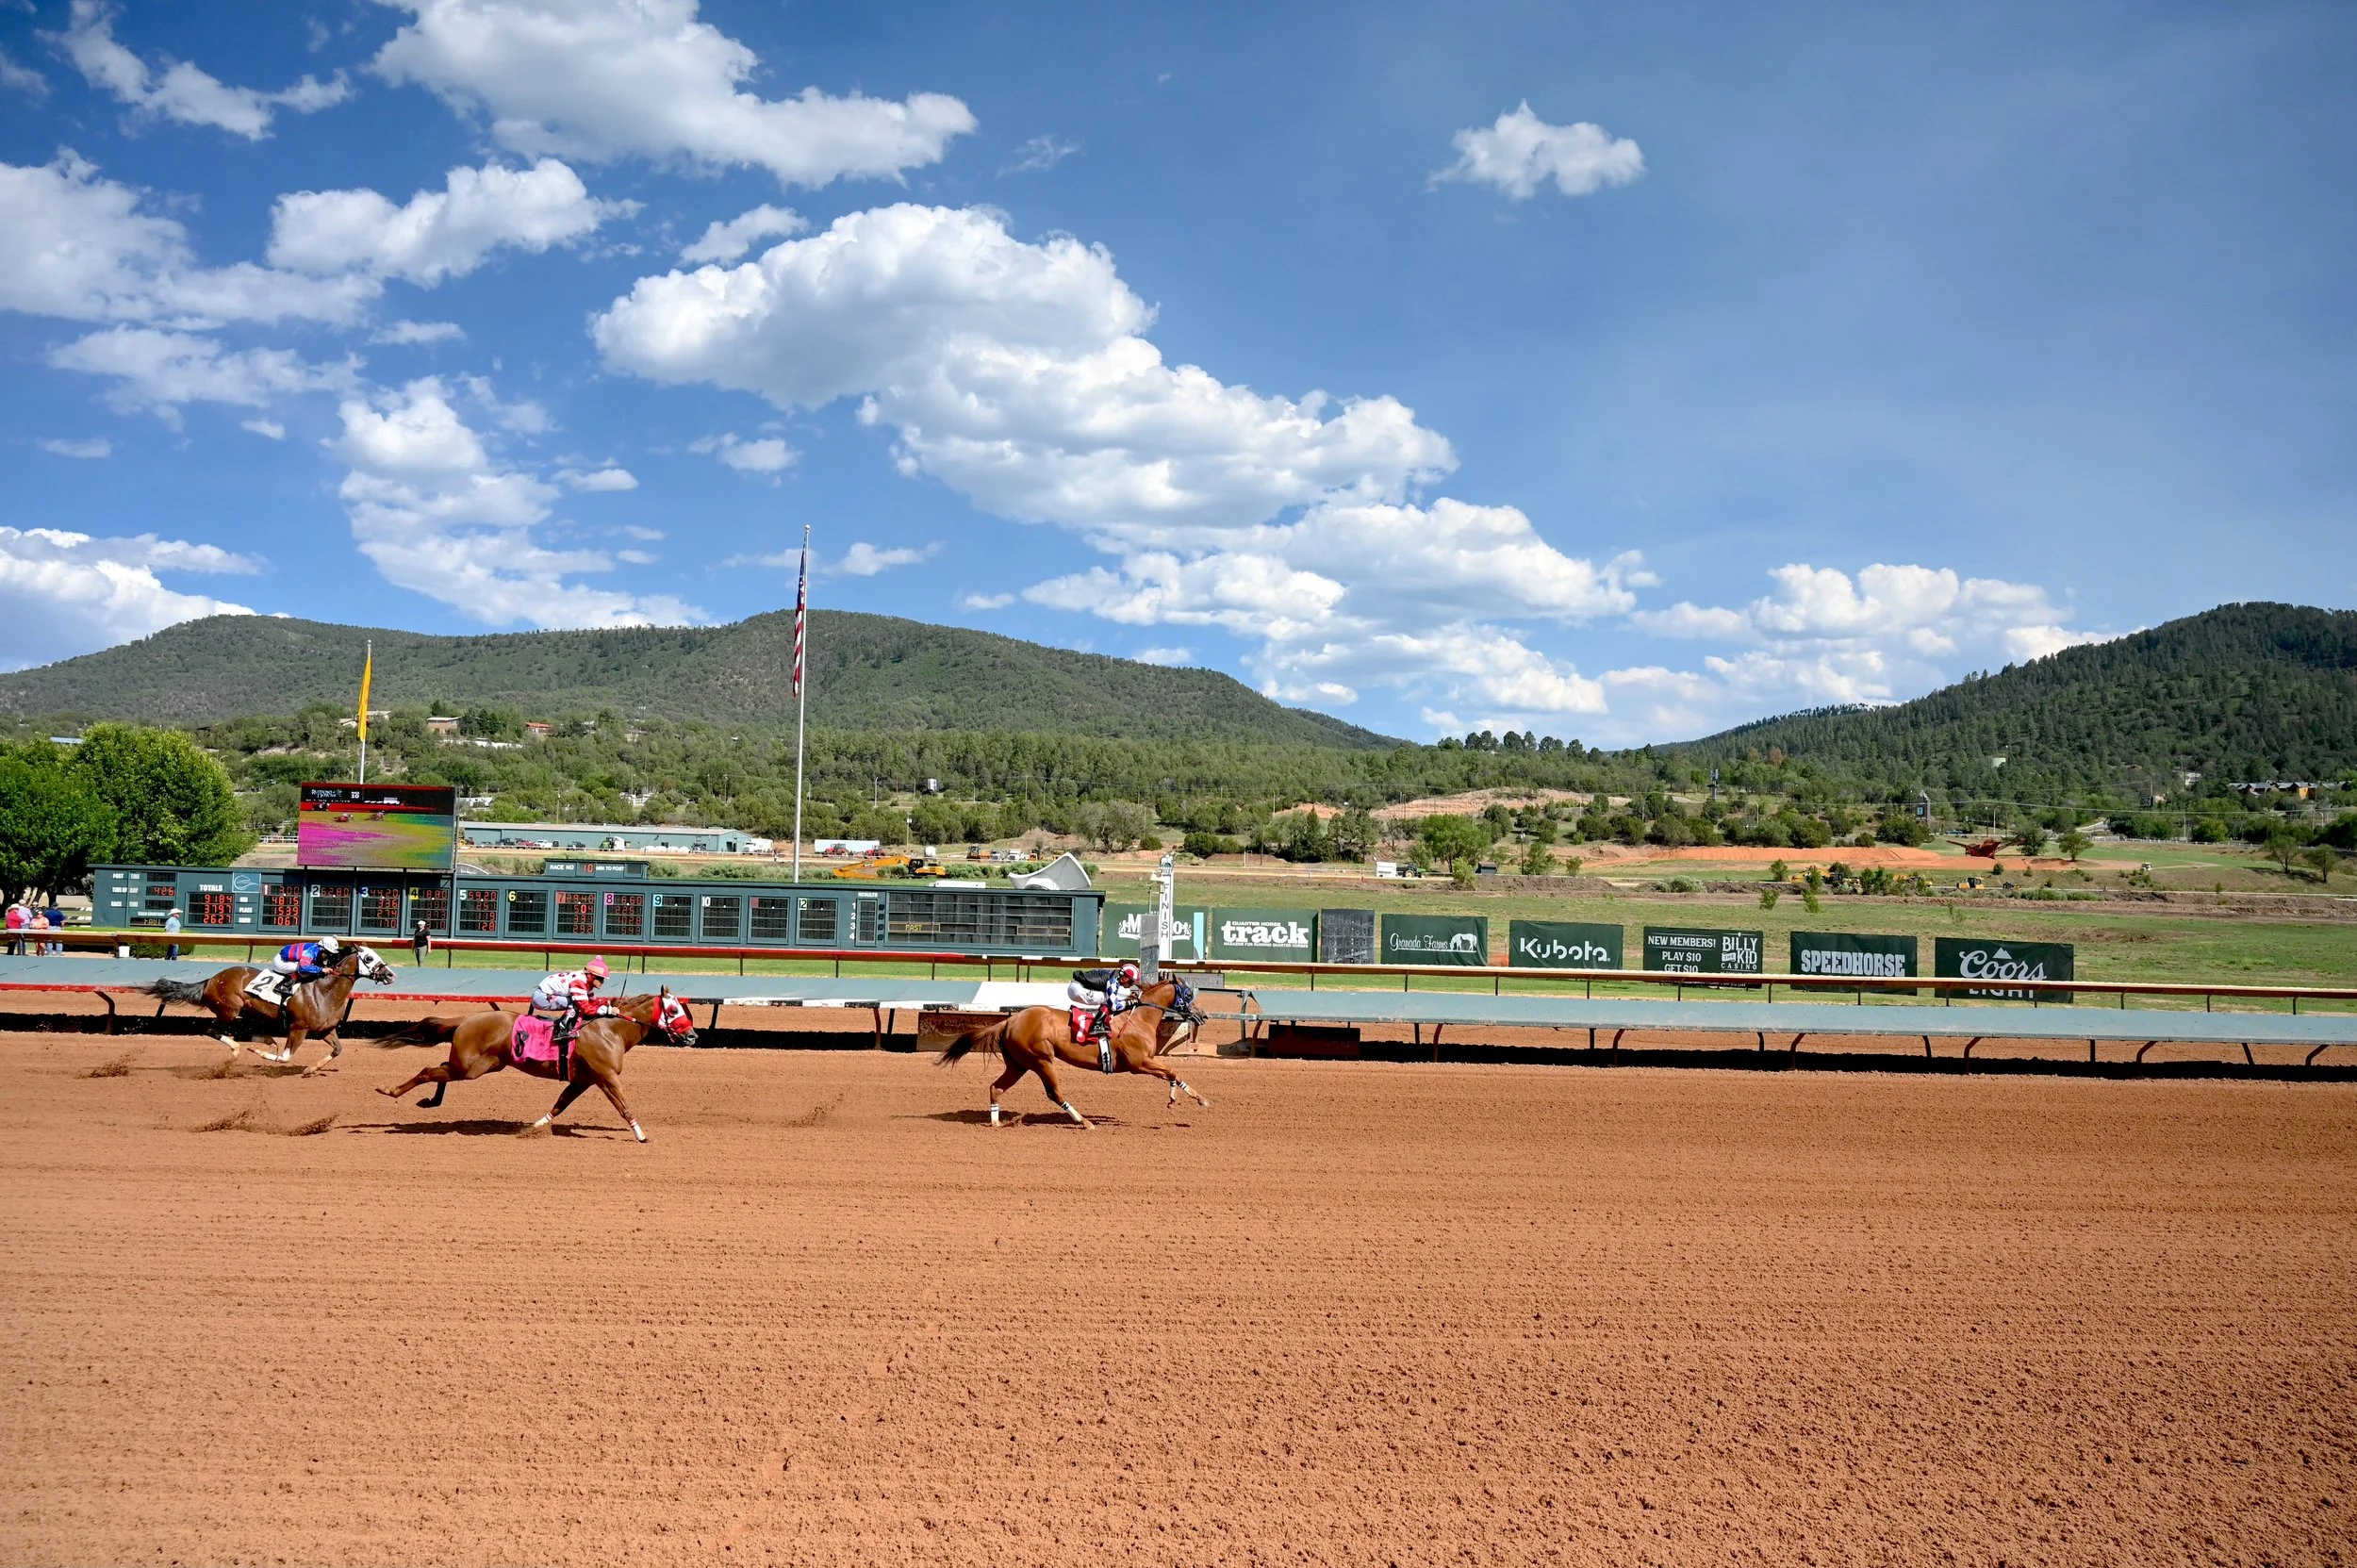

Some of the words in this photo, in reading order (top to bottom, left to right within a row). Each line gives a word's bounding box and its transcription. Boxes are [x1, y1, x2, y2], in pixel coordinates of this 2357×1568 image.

[584, 863, 594, 873] 10
[154, 886, 174, 896] 426
[312, 885, 320, 896] 2
[361, 886, 369, 897] 3
[410, 888, 418, 899] 4
[459, 890, 467, 900] 5
[205, 894, 233, 903] 9184
[272, 896, 300, 905] 4815
[508, 891, 516, 901] 6
[556, 892, 566, 902] 7
[605, 894, 614, 903] 8
[654, 896, 662, 905] 9
[378, 899, 398, 907] 336
[701, 896, 711, 907] 10
[799, 899, 807, 909] 12
[205, 904, 232, 914] 3797
[274, 906, 299, 916] 1539
[377, 909, 397, 917] 274
[573, 904, 594, 914] 504
[203, 915, 232, 924] 2627
[273, 916, 299, 926] 1067
[478, 921, 495, 932] 128
[1221, 920, 1310, 944] track
[1390, 933, 1421, 951] Granada
[1423, 934, 1448, 950] Farms
[1648, 935, 1668, 946] NEW
[1670, 936, 1716, 948] MEMBERS!
[1722, 936, 1757, 952] BILLY
[1520, 937, 1607, 962] Kubota
[1662, 951, 1685, 962] PLAY
[1686, 951, 1702, 963] $10
[1737, 950, 1757, 965] KID
[1721, 962, 1757, 970] CASINO
[1801, 949, 1905, 977] SPEEDHORSE
[1959, 949, 2047, 981] Coors
[1664, 964, 1681, 973] GET
[1683, 964, 1699, 974] $10
[252, 975, 274, 993] 2
[1077, 1015, 1086, 1037] 1
[515, 1030, 530, 1058] 8
